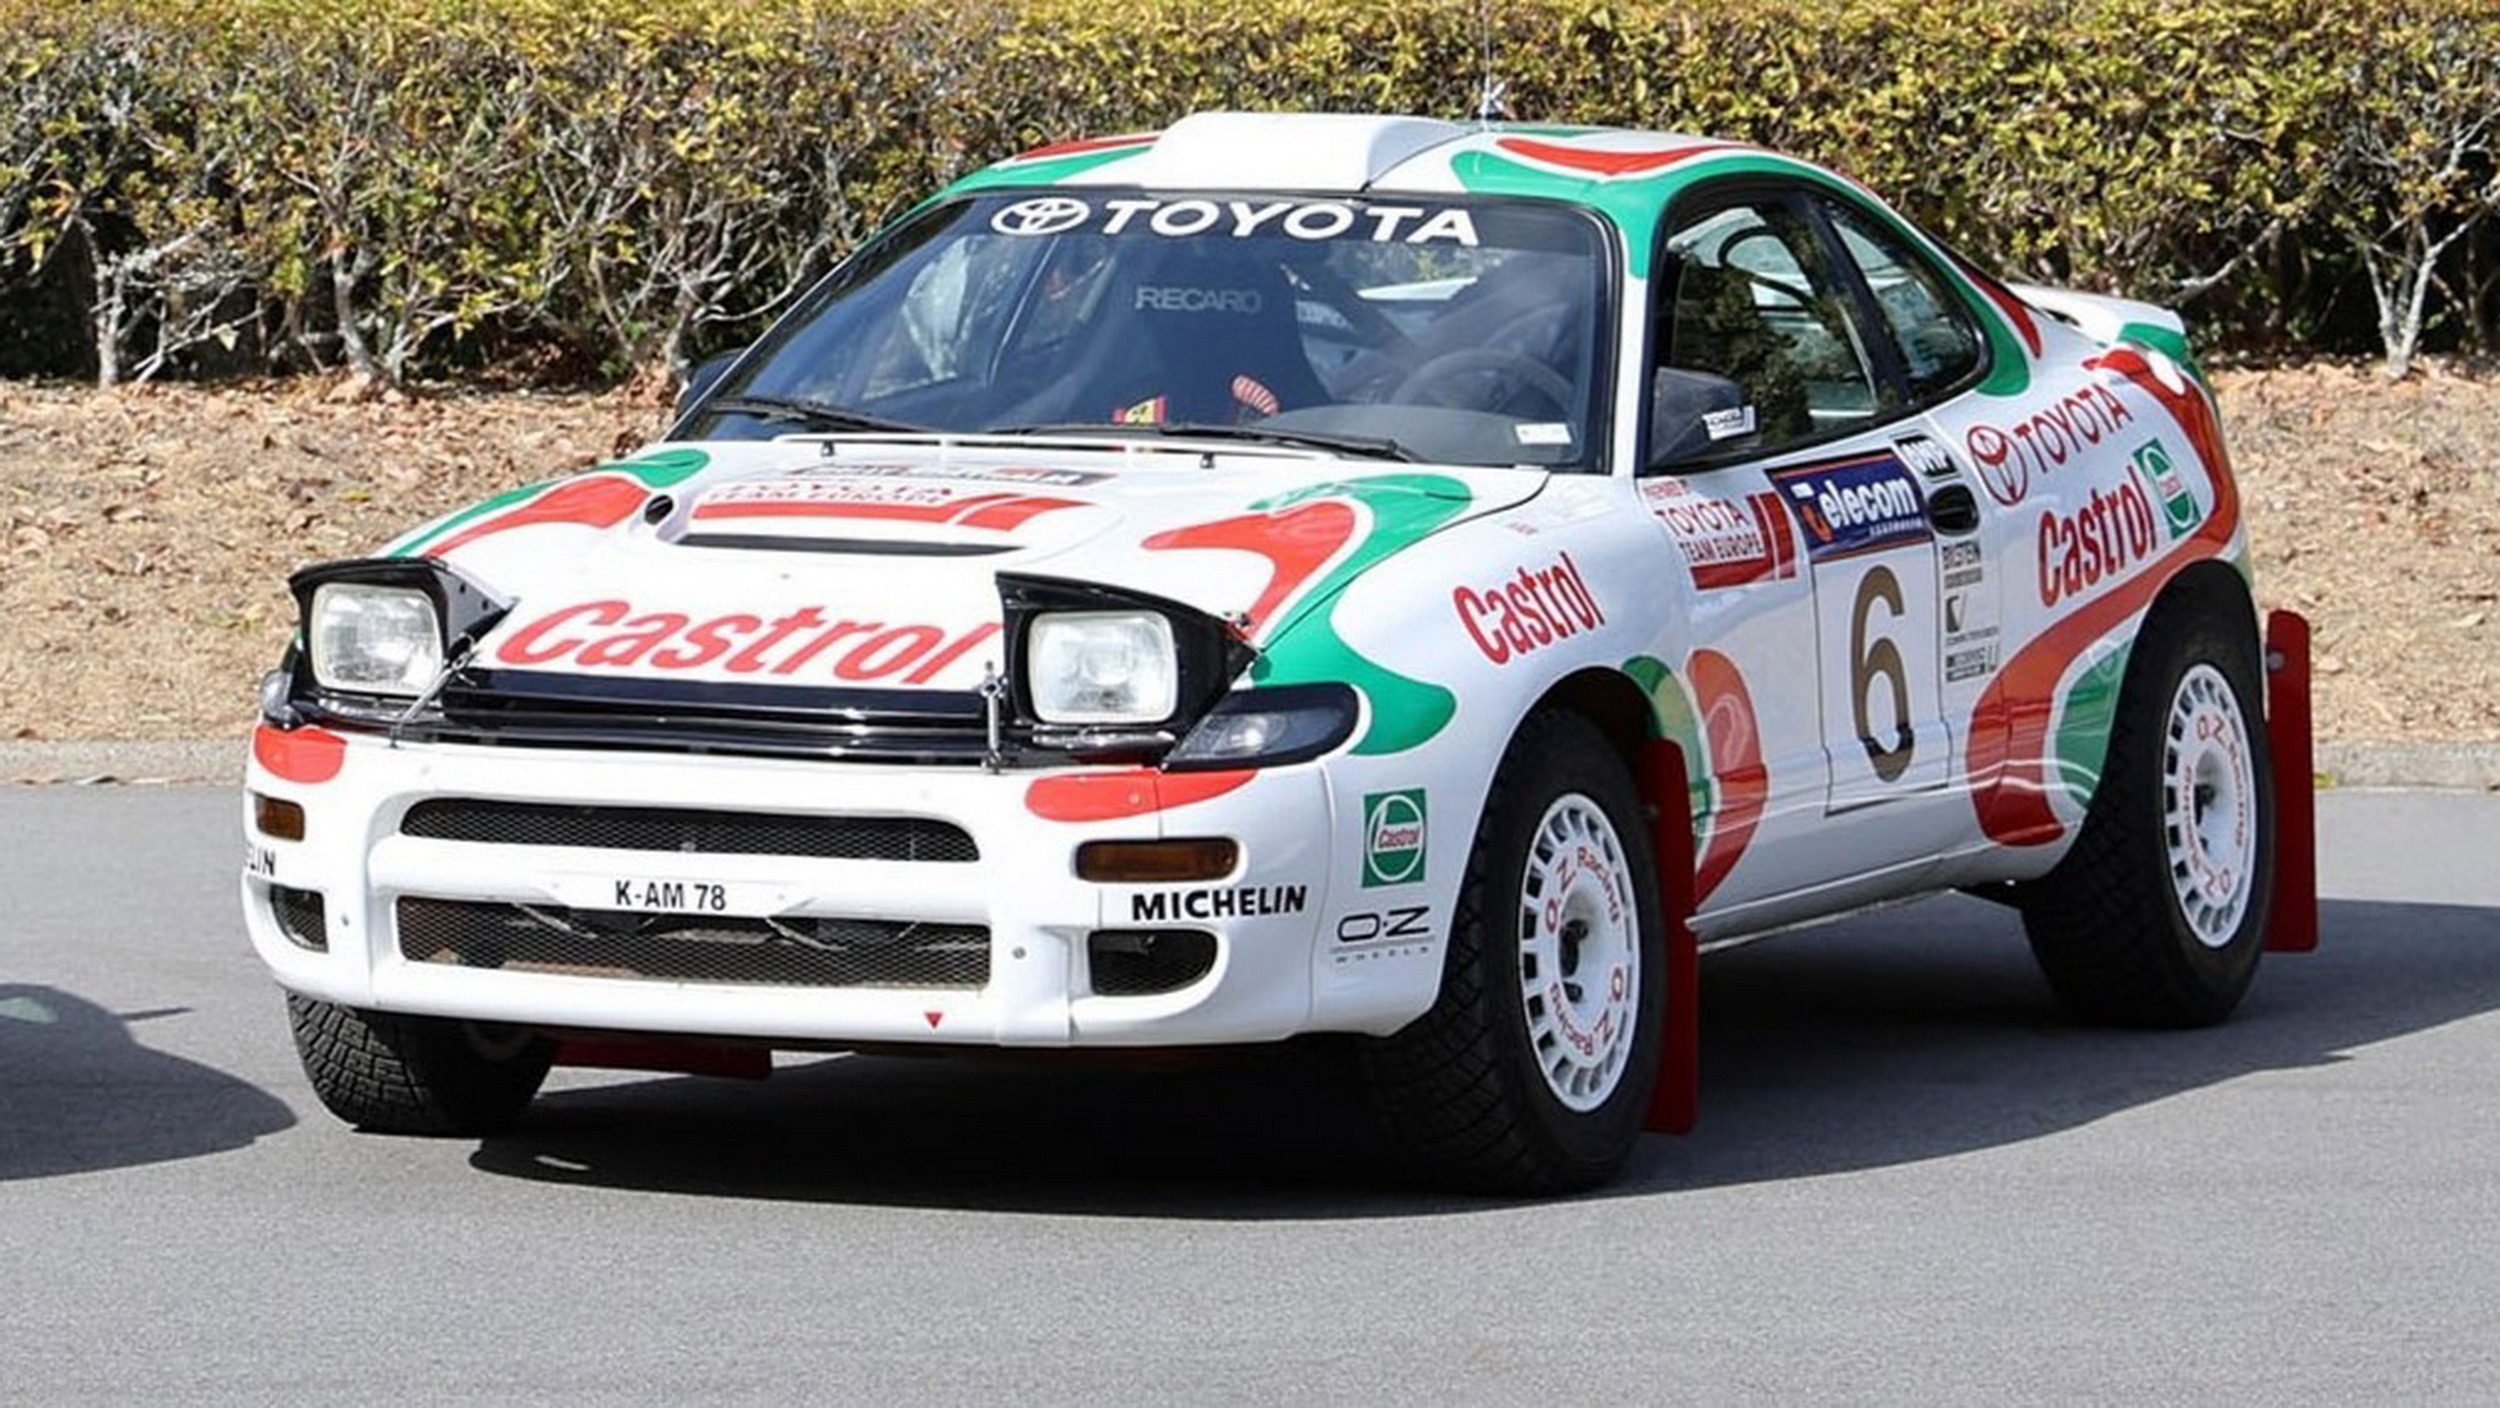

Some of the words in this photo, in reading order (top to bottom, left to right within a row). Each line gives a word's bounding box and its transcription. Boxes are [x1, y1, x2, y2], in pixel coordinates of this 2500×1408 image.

[1102, 199, 1479, 247] TOYOTA
[1135, 286, 1262, 314] RECARO
[2013, 383, 2133, 473] TOYOTA
[1654, 497, 1751, 536] TOYOTA
[2038, 465, 2156, 607] Castrol
[1679, 538, 1716, 562] TEAM
[1713, 533, 1764, 559] EUROPE
[1453, 550, 1606, 664] Castrol
[495, 599, 1004, 685] Castrol
[1852, 564, 1915, 783] 6
[1378, 827, 1421, 850] Castrol
[615, 880, 685, 908] K-AM
[694, 883, 727, 911] 78
[1132, 885, 1307, 921] MICHELIN
